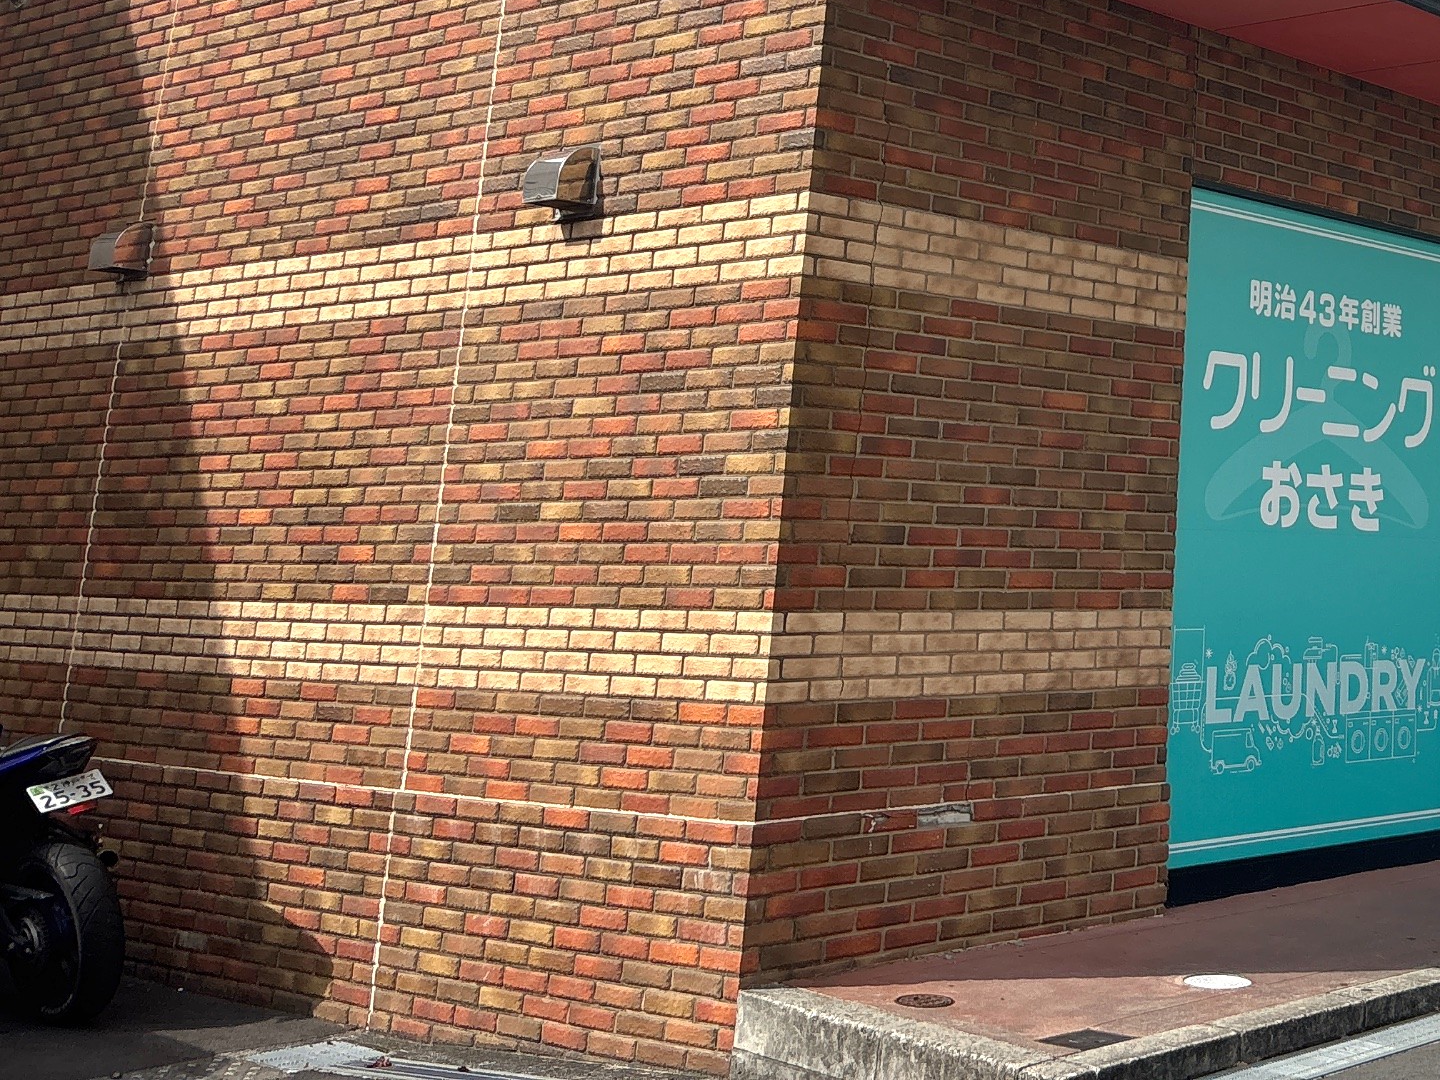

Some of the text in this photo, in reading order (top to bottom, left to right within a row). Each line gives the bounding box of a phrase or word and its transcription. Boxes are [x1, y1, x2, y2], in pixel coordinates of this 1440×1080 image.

[1249, 279, 1403, 338] 明治43年創業
[1202, 350, 1436, 448] クリーニング
[1259, 460, 1384, 532] おさき
[1204, 658, 1427, 724] LAUNDRY
[40, 780, 106, 810] 25-35
